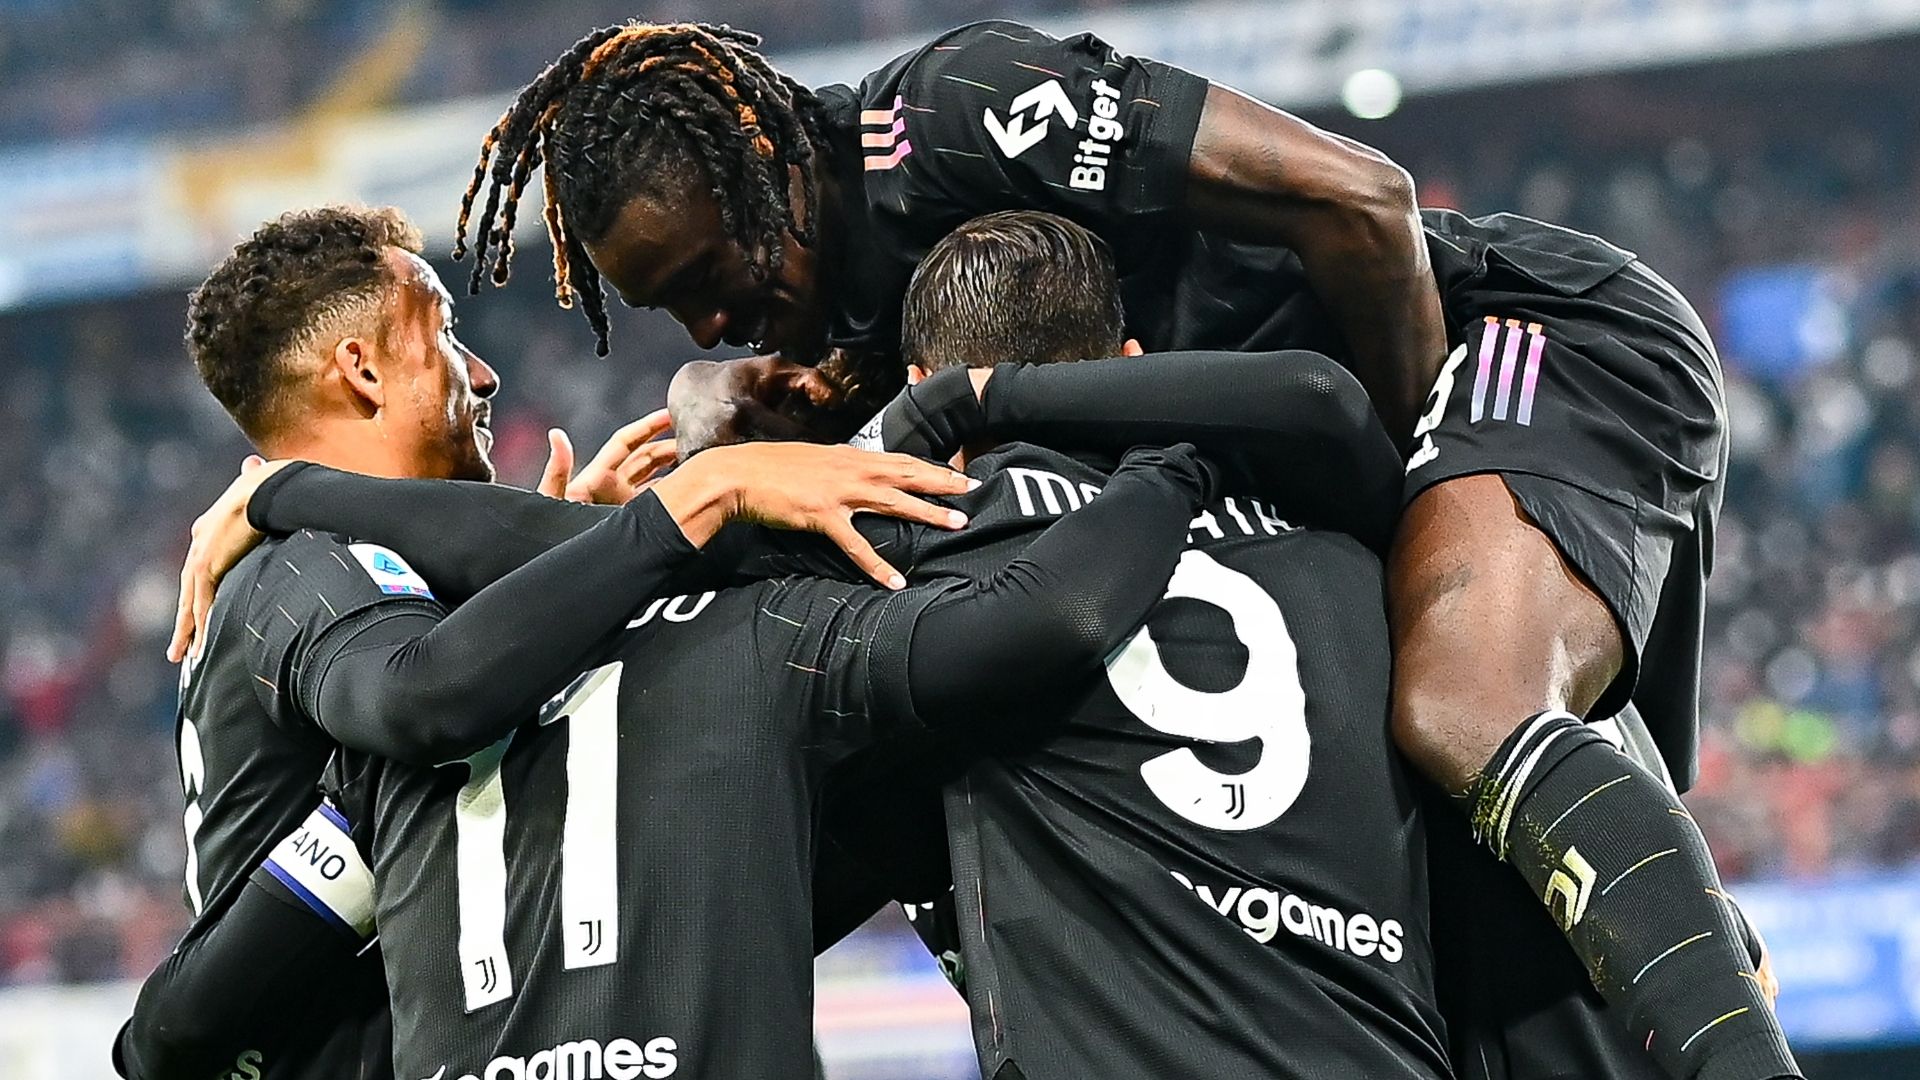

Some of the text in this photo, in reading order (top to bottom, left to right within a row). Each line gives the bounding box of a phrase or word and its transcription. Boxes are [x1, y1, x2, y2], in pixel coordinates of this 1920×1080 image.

[1069, 78, 1124, 191] Bitget
[1104, 548, 1312, 832] 9
[433, 660, 624, 1014] 11
[1169, 870, 1404, 963] ygames
